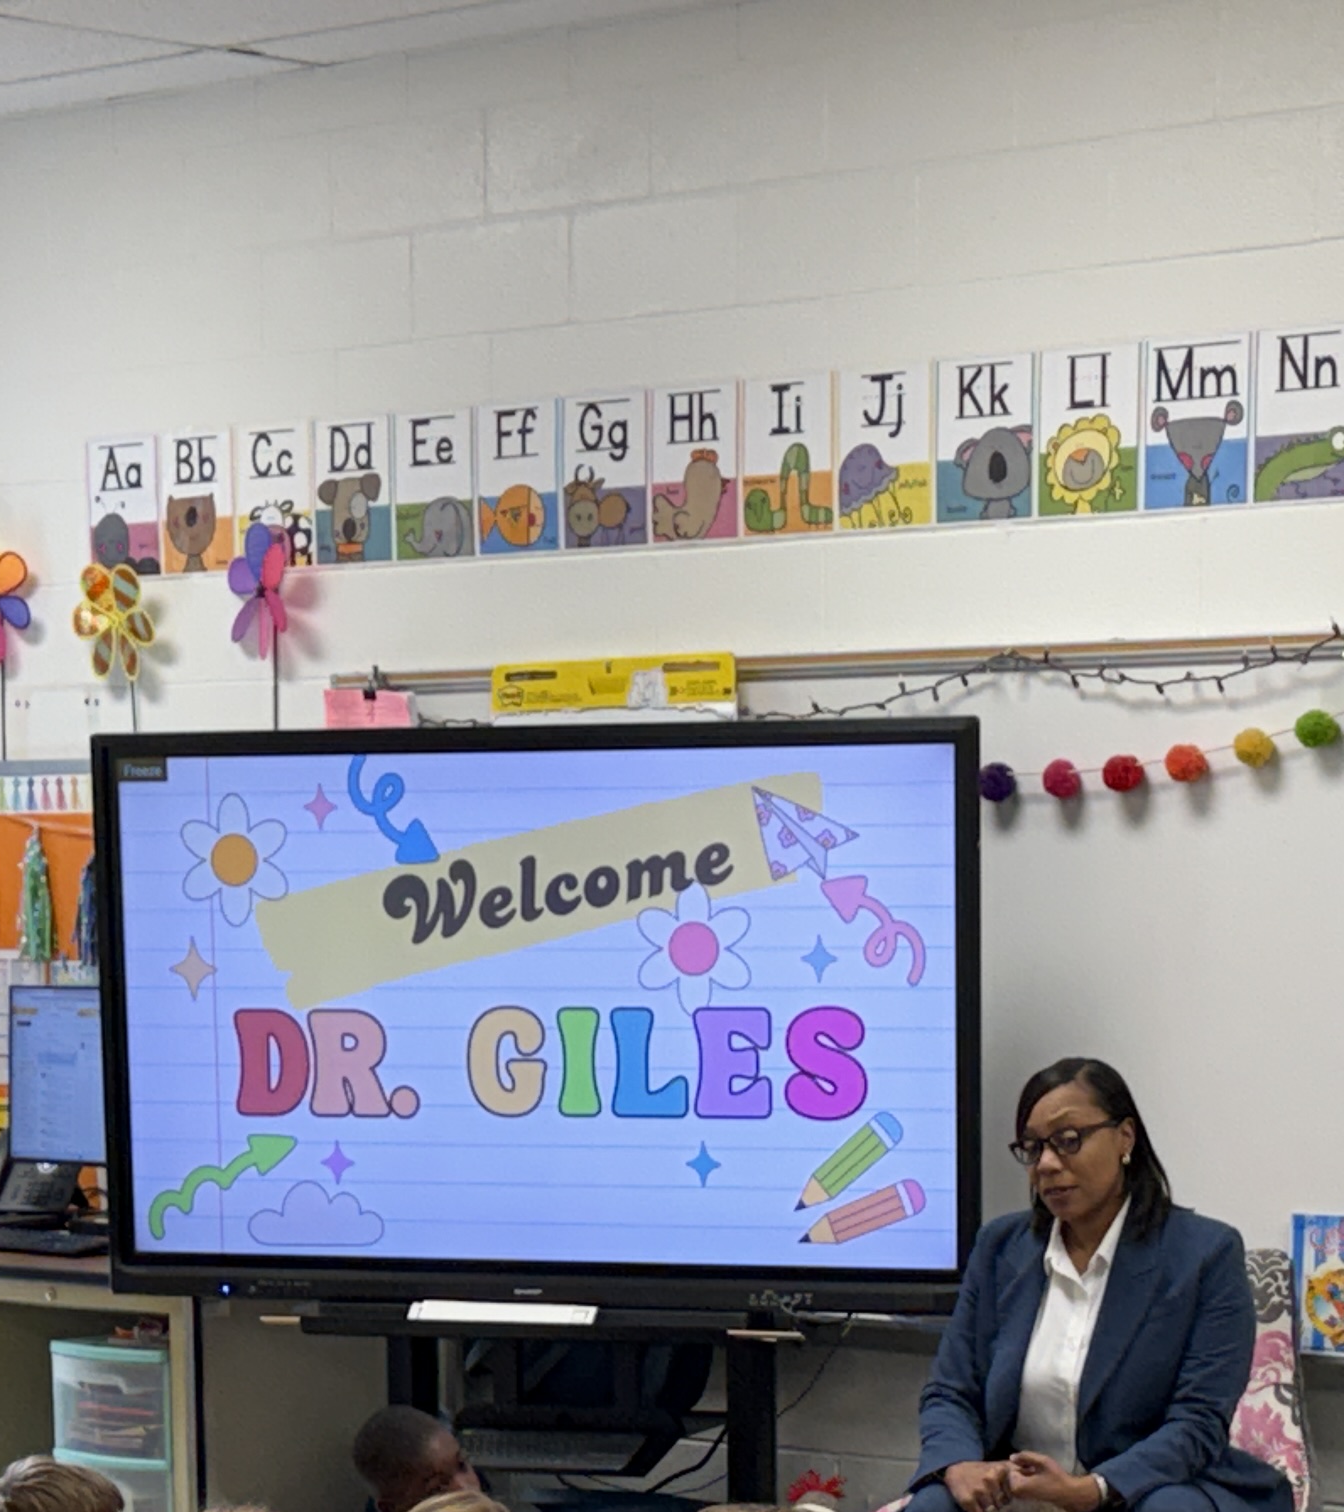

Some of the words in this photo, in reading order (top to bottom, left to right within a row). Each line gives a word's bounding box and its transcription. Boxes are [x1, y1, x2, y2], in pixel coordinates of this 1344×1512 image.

[1069, 353, 1111, 409] Ll
[1157, 345, 1239, 402] Mm
[1279, 335, 1339, 390] Nn
[669, 392, 718, 443] Hh
[770, 384, 804, 435] Ii
[863, 374, 904, 438] Jj
[959, 365, 1010, 418] Kk
[251, 433, 294, 477] Cc
[329, 425, 374, 472] Dd
[411, 418, 454, 467] Ee
[496, 410, 537, 457] Ff
[578, 401, 629, 462] Gg
[101, 446, 143, 490] Aa
[176, 440, 217, 484] Bb
[383, 839, 737, 946] Welcome
[233, 1007, 422, 1118] DR.
[466, 1004, 869, 1120] GILES
